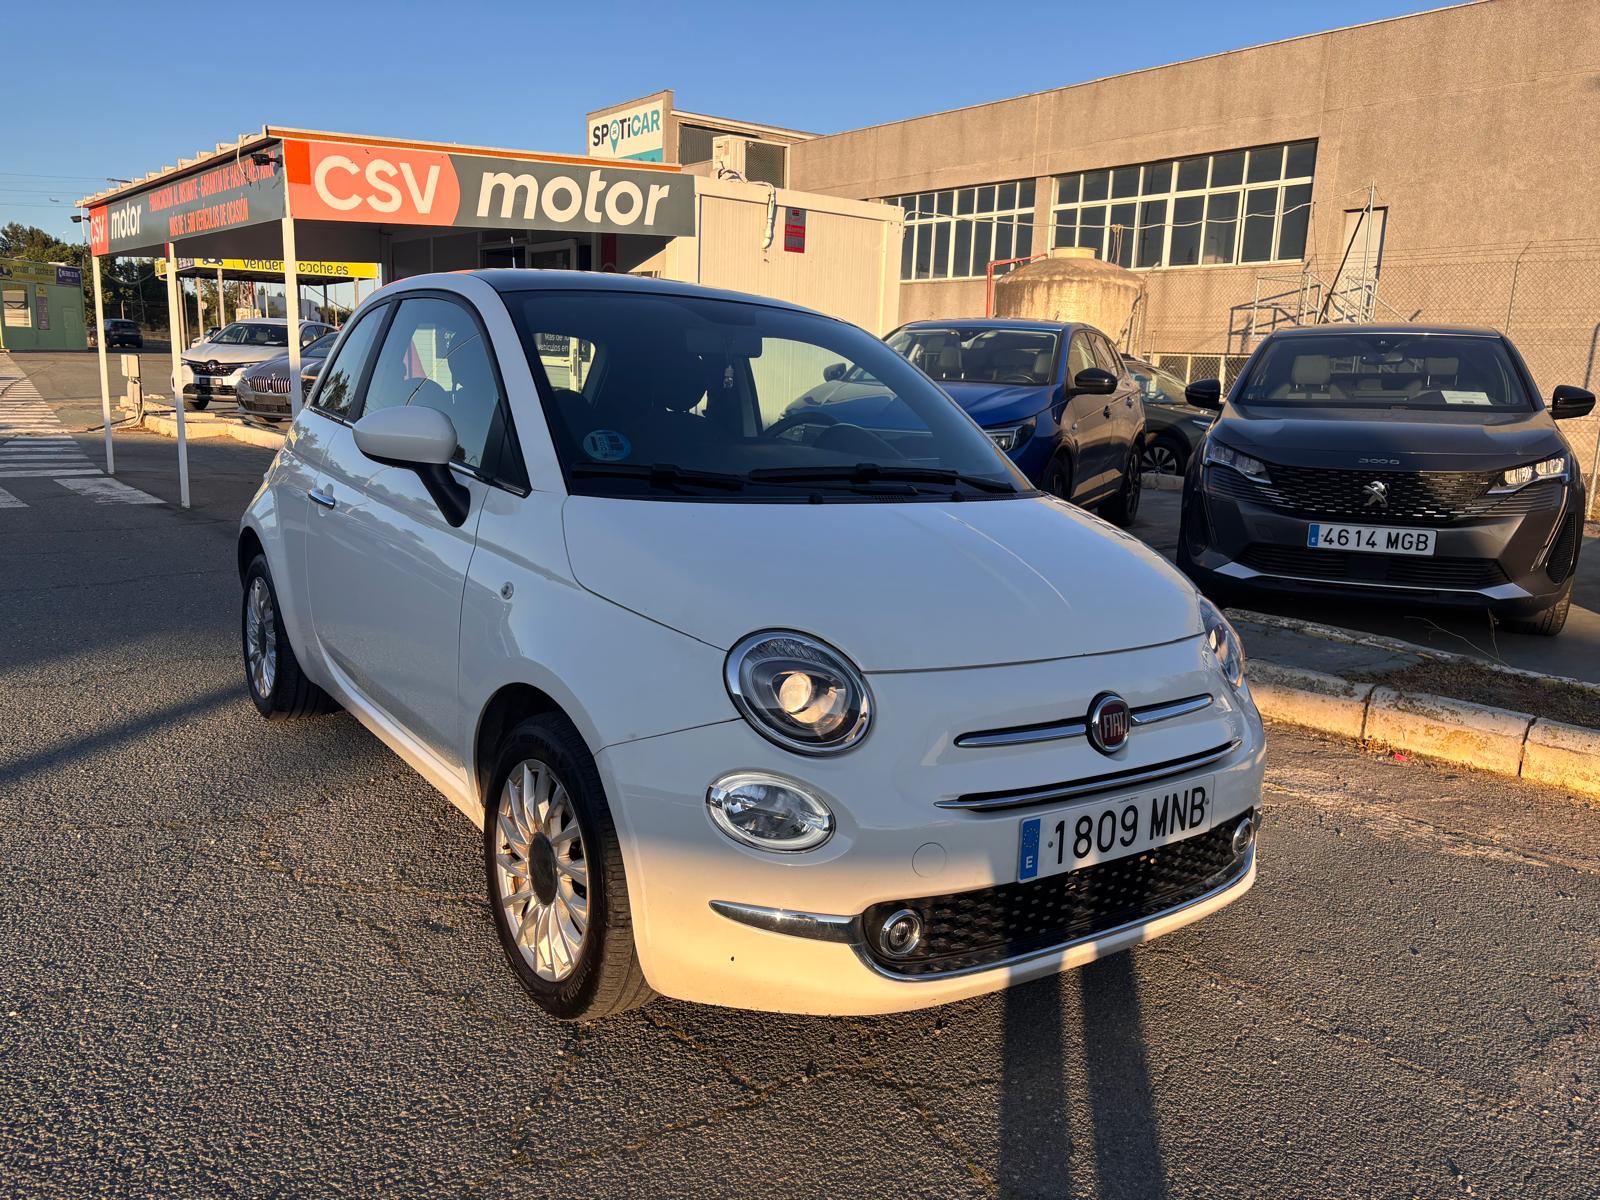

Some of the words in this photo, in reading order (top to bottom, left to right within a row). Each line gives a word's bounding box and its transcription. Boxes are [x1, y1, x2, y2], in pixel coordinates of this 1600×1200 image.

[314, 154, 441, 214] CSV
[476, 169, 670, 226] motor
[91, 213, 104, 244] CSV
[111, 201, 142, 240] motor
[1323, 528, 1377, 548] 4614
[1386, 531, 1428, 551] MGB
[1103, 712, 1128, 739] FIAT
[1025, 855, 1033, 869] E
[1055, 805, 1138, 864] 1809
[1150, 786, 1206, 840] MNB
